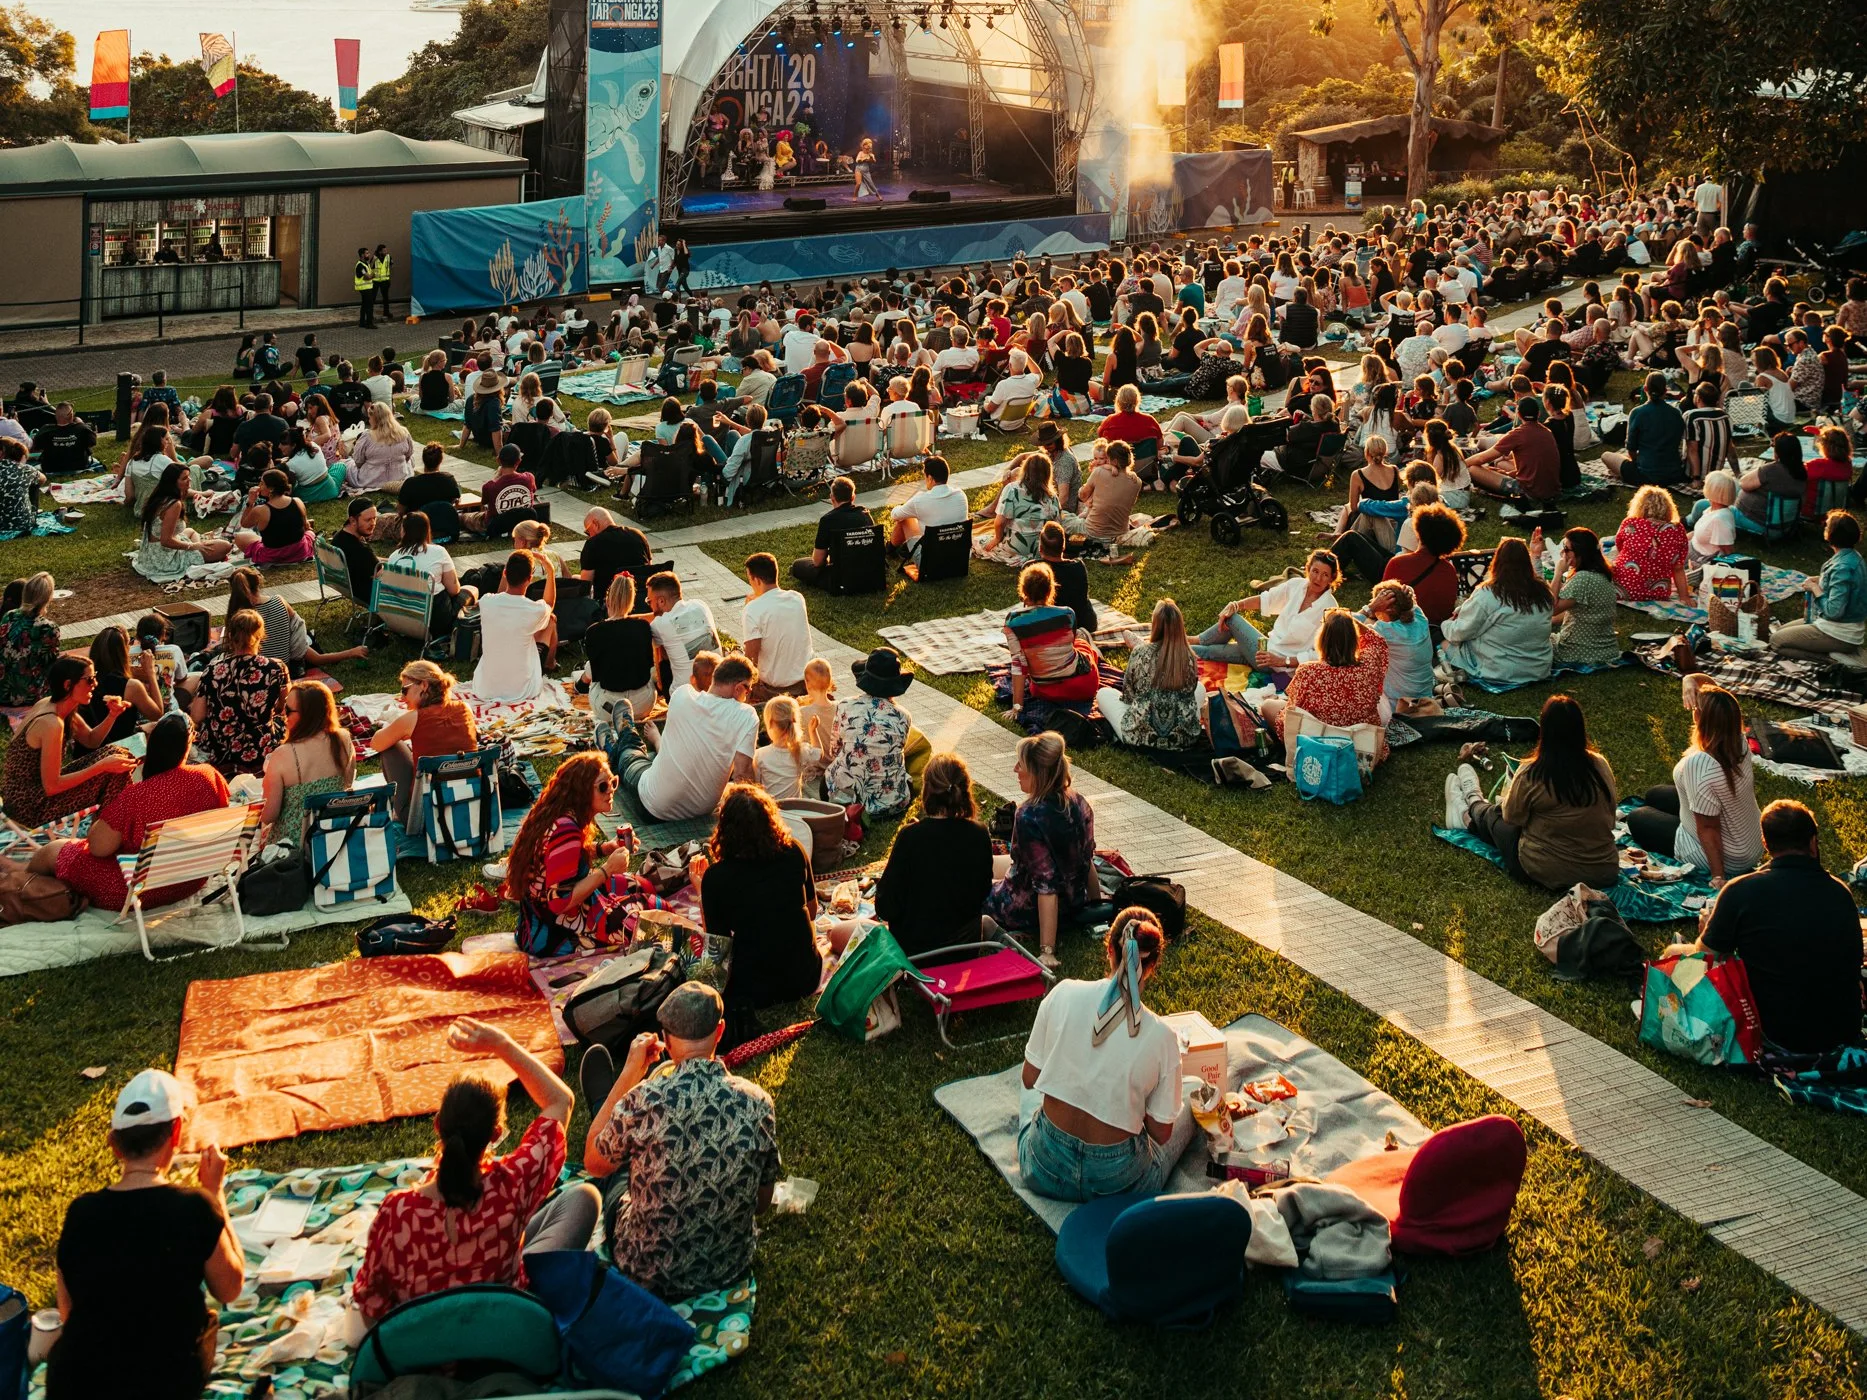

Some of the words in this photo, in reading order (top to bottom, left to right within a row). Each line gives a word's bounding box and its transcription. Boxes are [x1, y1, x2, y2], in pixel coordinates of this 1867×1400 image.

[591, 3, 644, 21] TARONGA
[644, 3, 659, 20] 23
[771, 54, 786, 89] AT
[788, 54, 816, 89] 20
[500, 495, 530, 510] DTAC
[442, 760, 471, 769] Coleman
[331, 797, 363, 805] Coleman
[1201, 1064, 1219, 1073] Good
[1207, 1072, 1221, 1080] Pair
